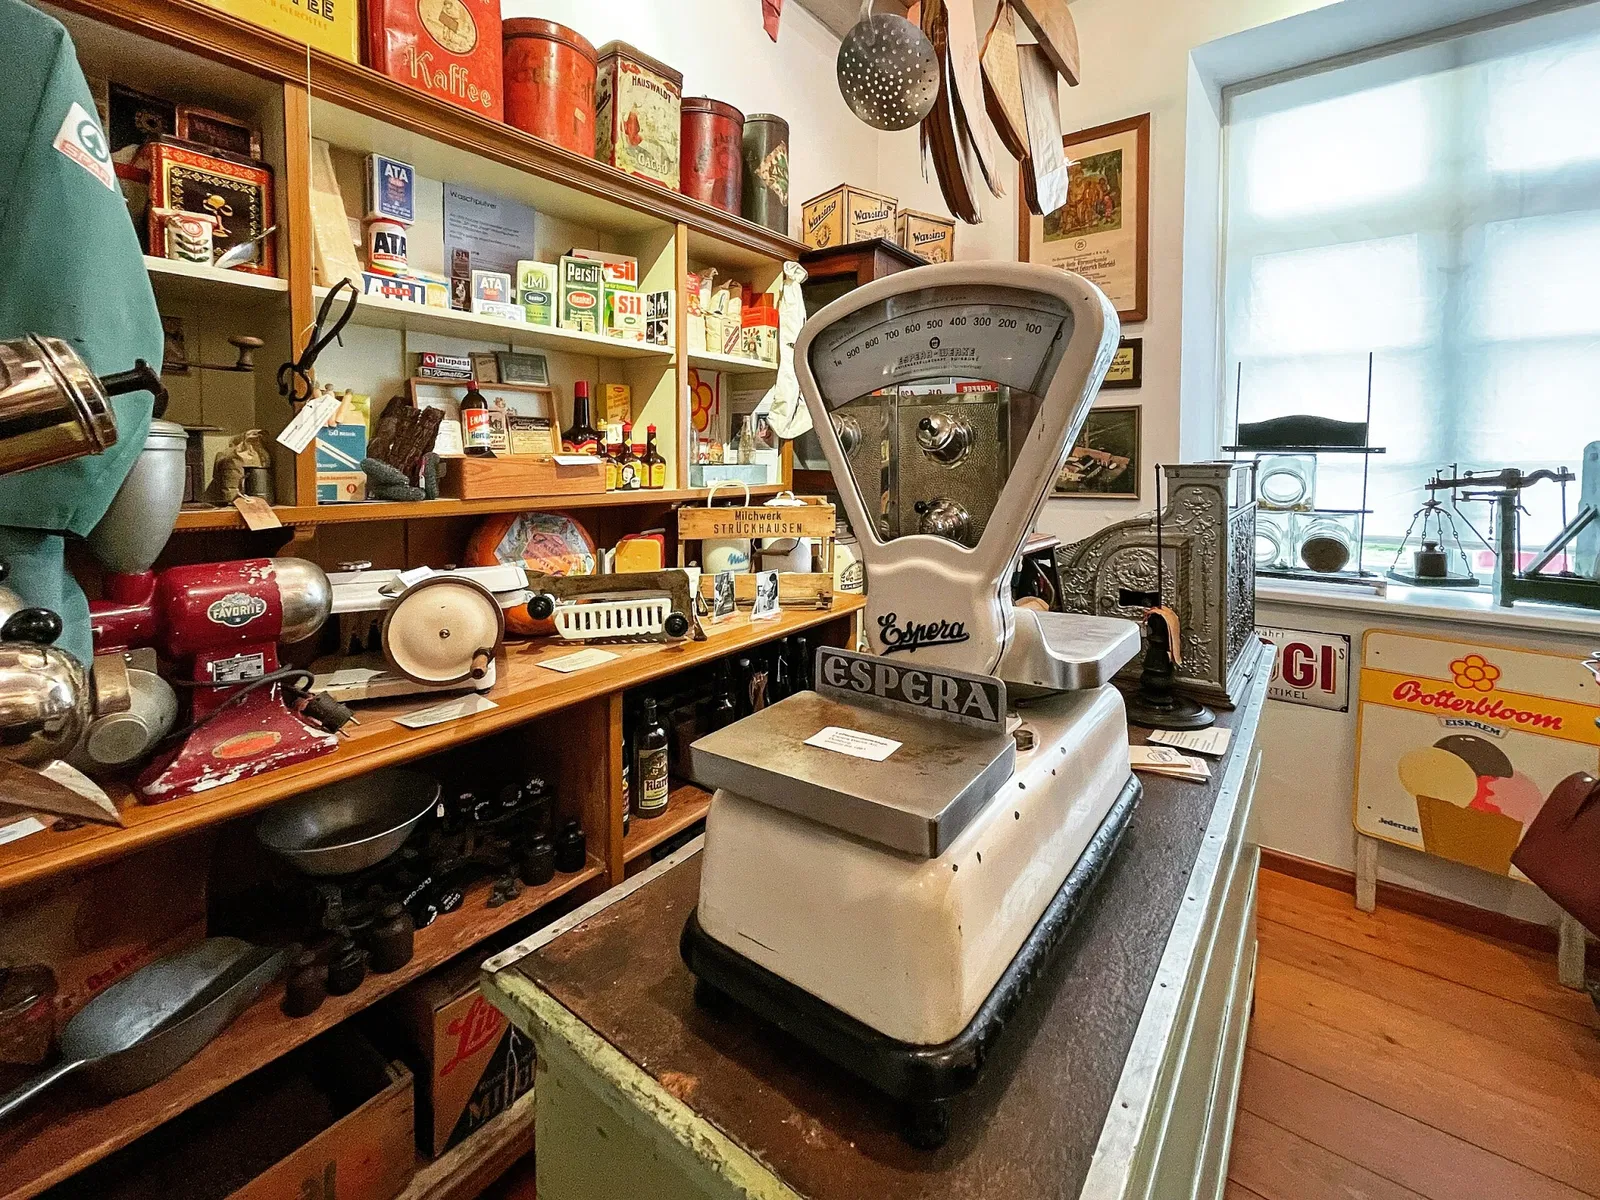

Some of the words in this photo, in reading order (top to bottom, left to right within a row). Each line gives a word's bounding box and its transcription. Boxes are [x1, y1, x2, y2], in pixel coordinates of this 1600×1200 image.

[408, 47, 492, 108] Kaffee
[631, 75, 671, 104] HAUSWALDT
[61, 139, 111, 187] SPAR
[384, 163, 408, 183] ATA
[450, 190, 497, 210] Waschpulver
[373, 232, 407, 257] ATA
[567, 263, 598, 283] Persil
[479, 276, 503, 292] ATA
[618, 295, 642, 315] Sil
[846, 346, 860, 360] 900
[864, 336, 880, 349] 800
[884, 329, 900, 341] 700
[904, 322, 921, 334] 600
[926, 318, 943, 330] 500
[949, 316, 967, 327] 400
[973, 317, 991, 327] 300
[997, 318, 1017, 329] 200
[1025, 322, 1042, 335] 100
[735, 510, 782, 521] Milchwerk
[713, 521, 803, 534] STRÜCKHAUSEN
[212, 602, 262, 620] FAVORITE
[877, 612, 970, 656] Espera
[824, 655, 997, 721] ESPERA
[1393, 680, 1563, 731] Botterbloom
[1445, 717, 1502, 737] EISKREM
[1378, 816, 1419, 834] Jederzeit
